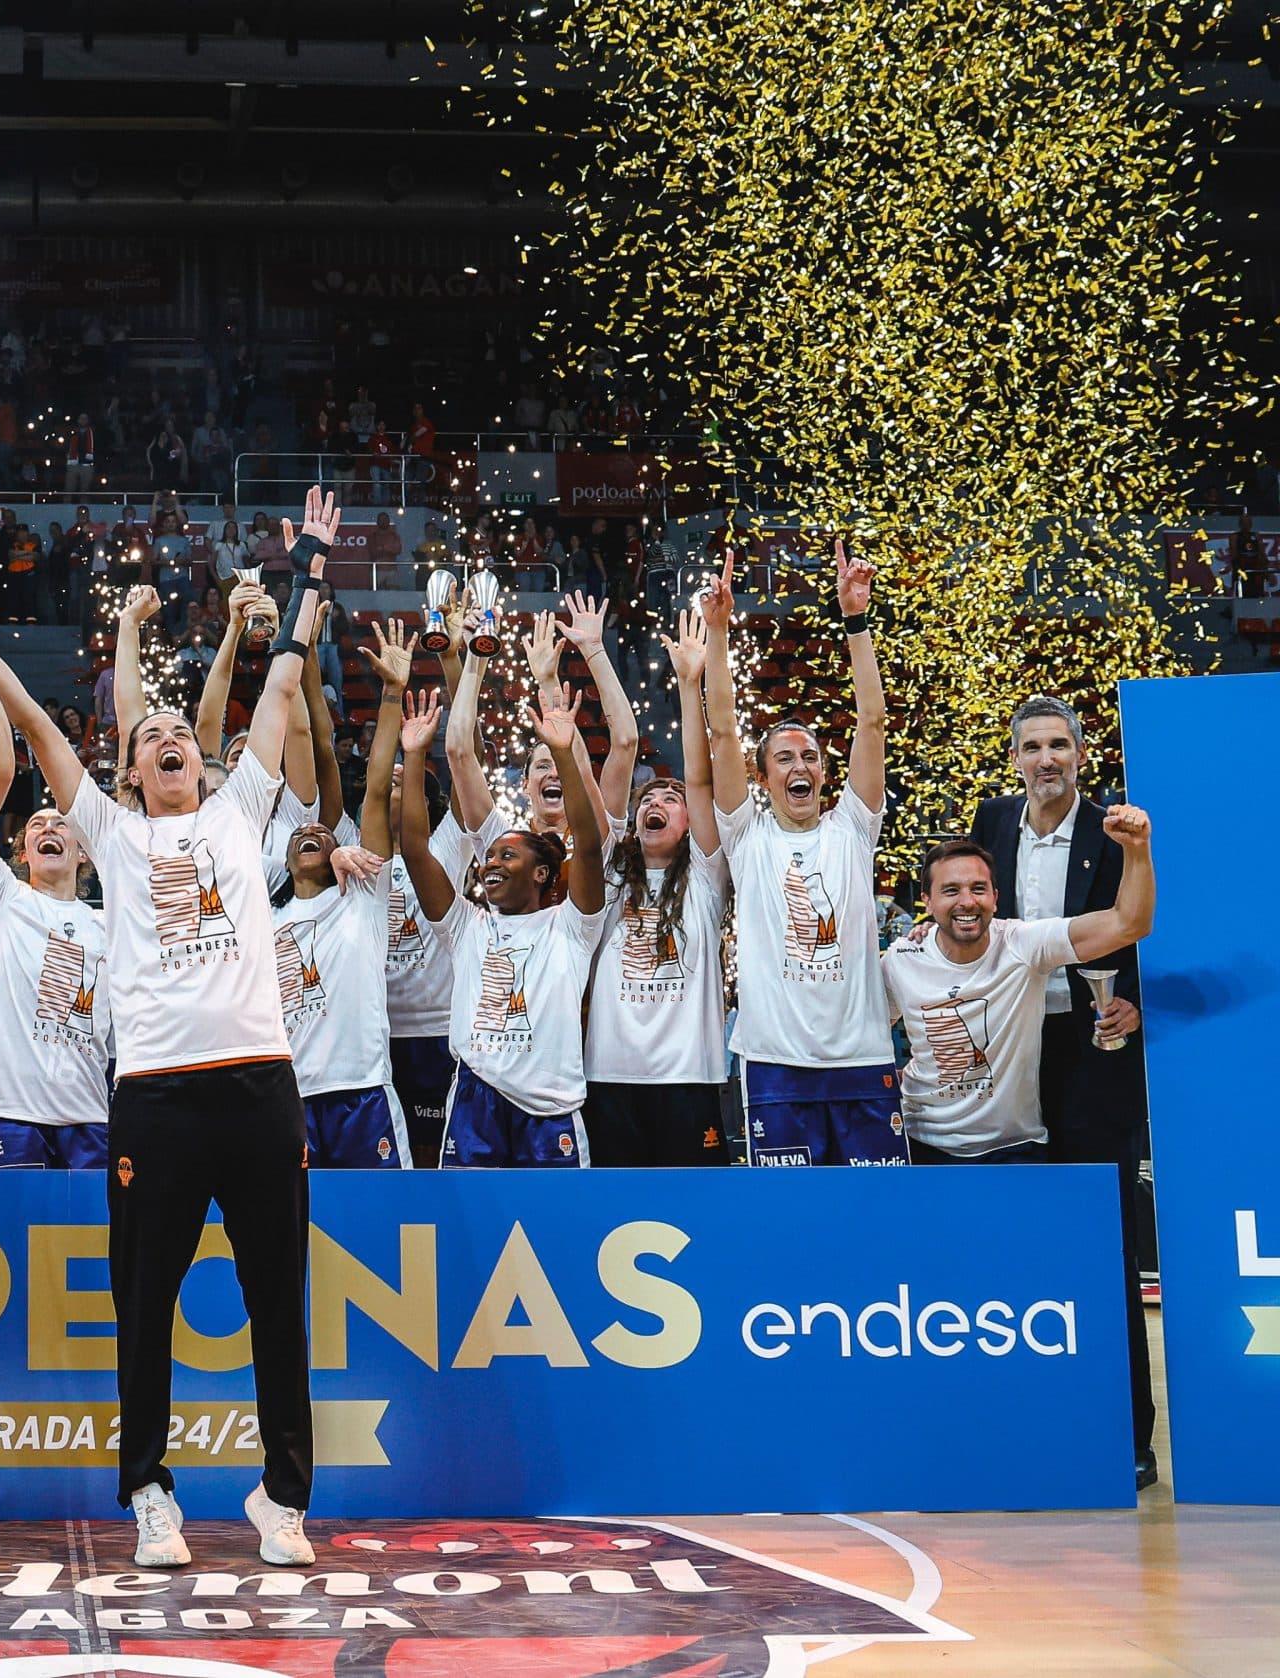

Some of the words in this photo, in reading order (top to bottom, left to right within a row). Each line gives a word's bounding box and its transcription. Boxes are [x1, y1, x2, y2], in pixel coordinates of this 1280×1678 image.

[505, 494, 532, 502] EXIT
[572, 482, 674, 506] podoactiv
[160, 947, 173, 959] LF
[186, 938, 239, 954] ENDESA
[161, 951, 240, 973] 2024/25
[640, 982, 685, 992] ENDESA
[619, 993, 685, 1003] 2024/25
[34, 1020, 47, 1030] LF
[470, 1032, 481, 1041] LF
[414, 1105, 445, 1119] Vital
[741, 1283, 1077, 1359] endesa
